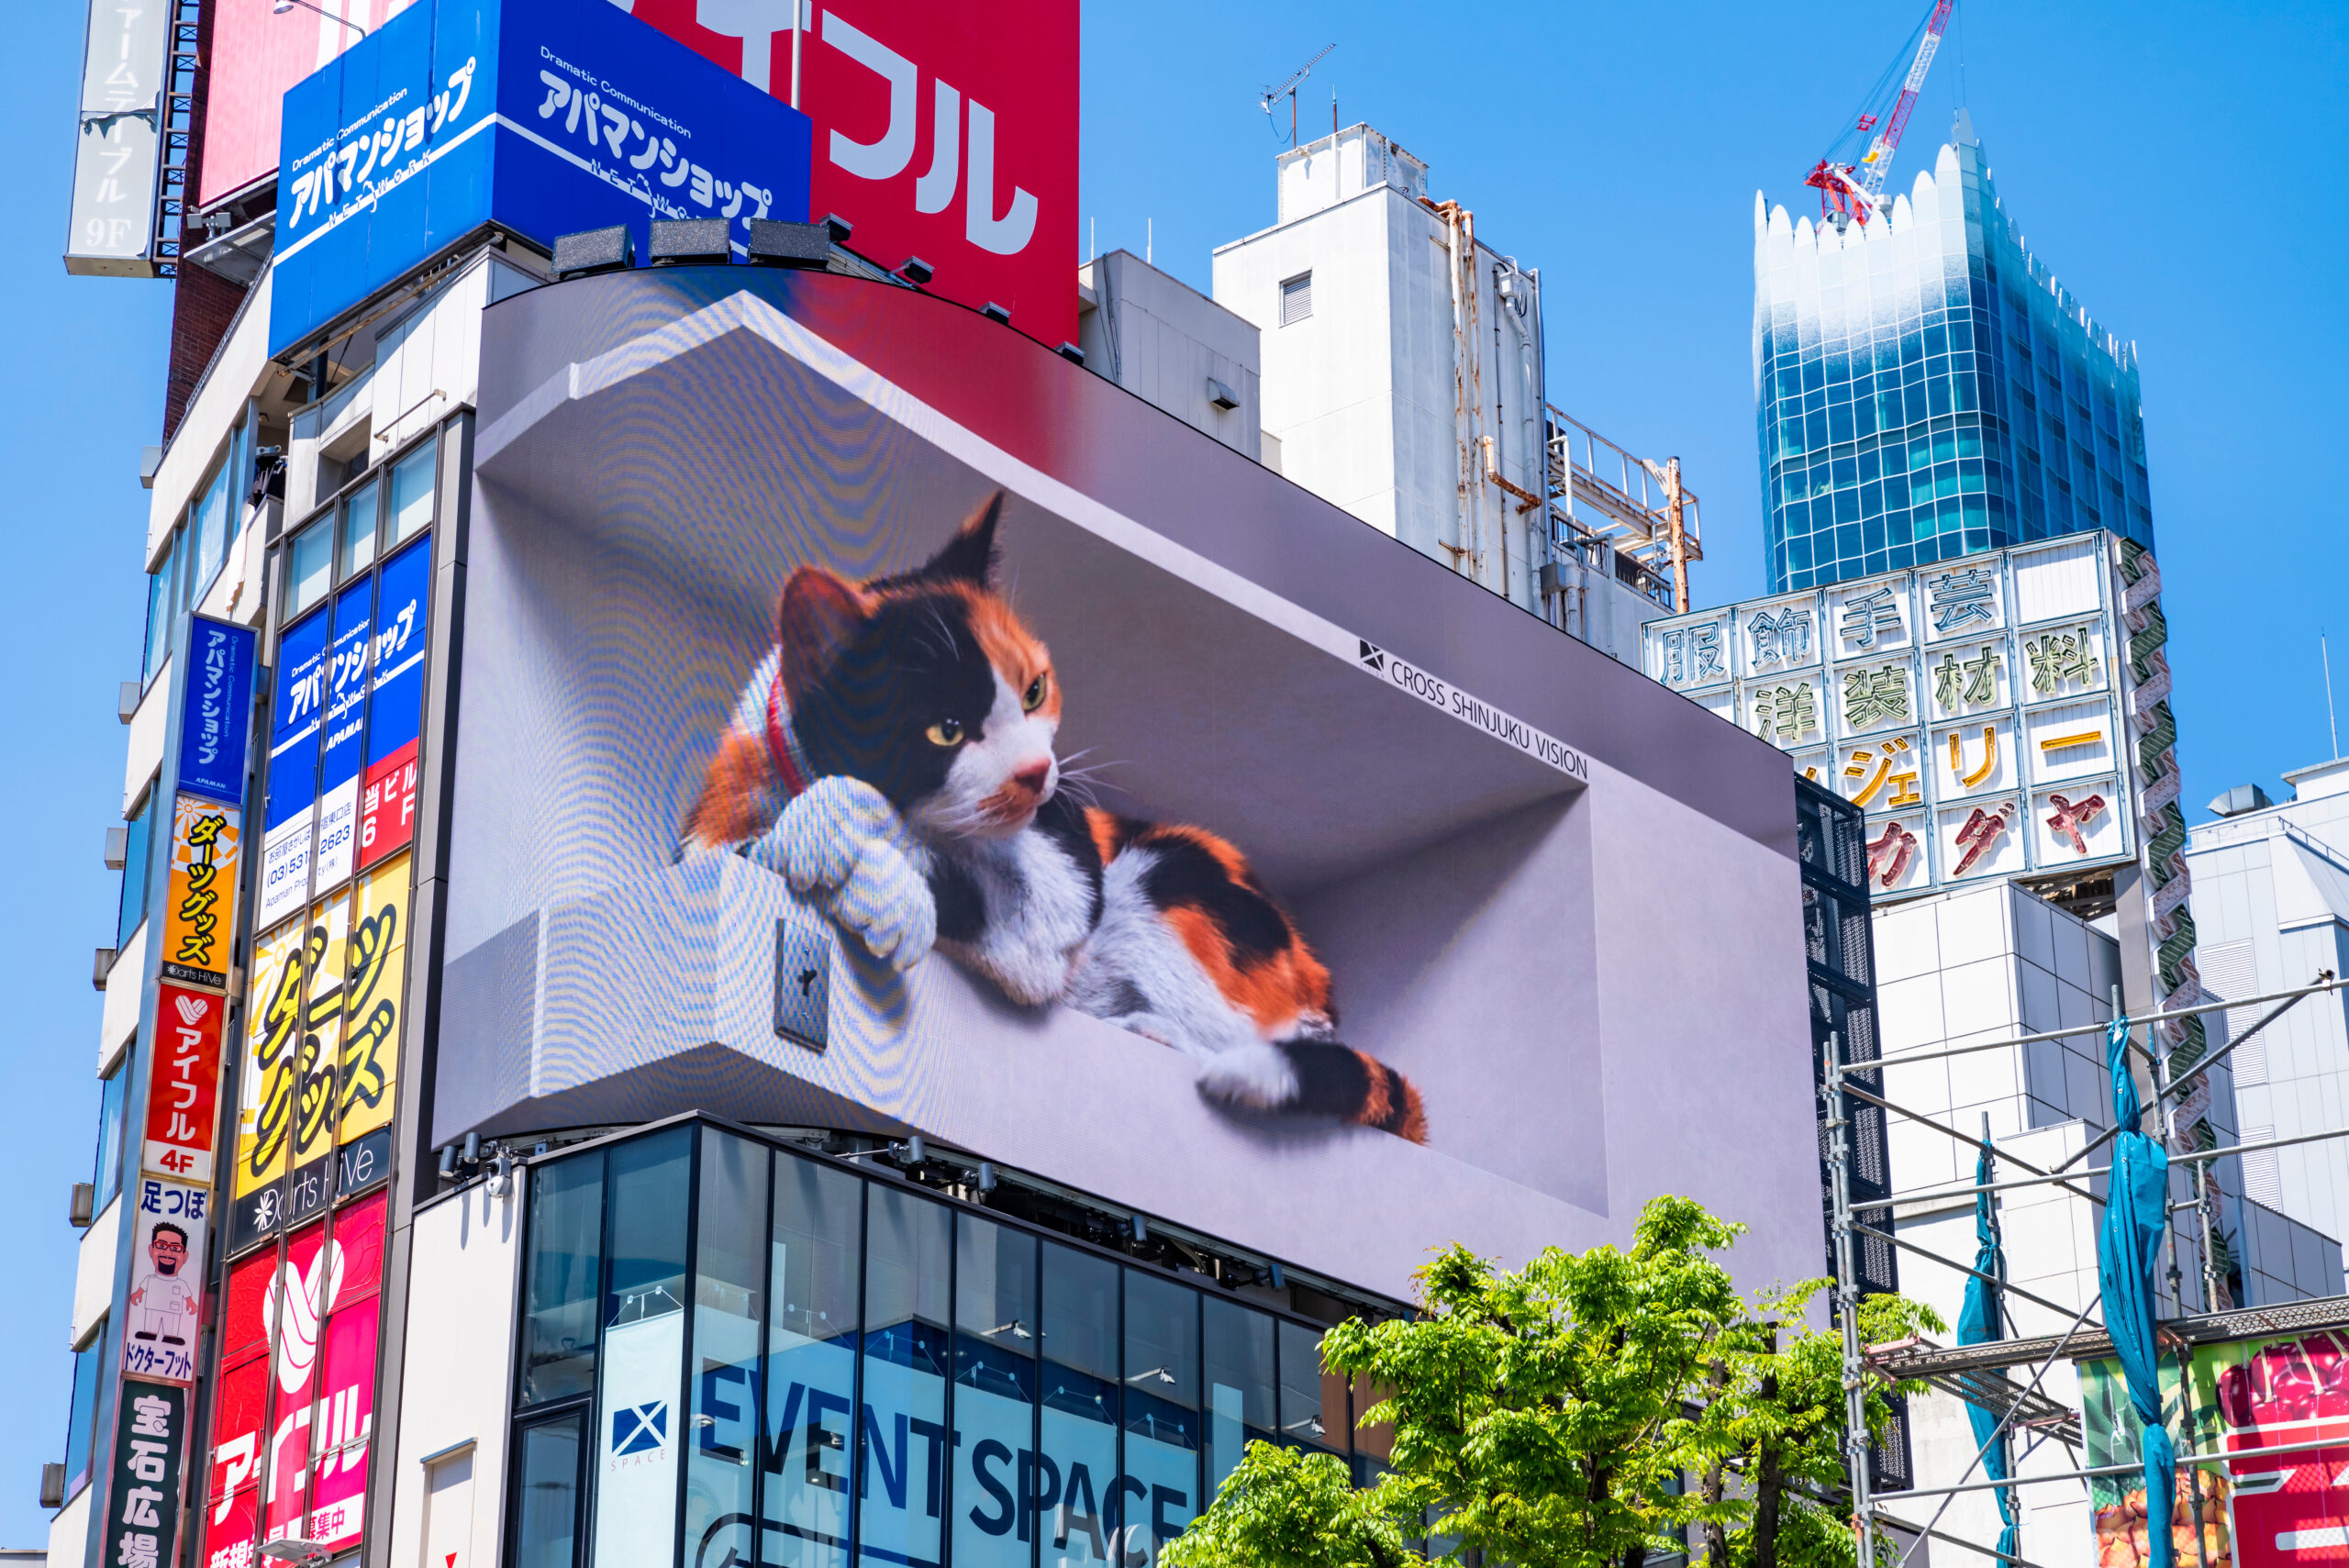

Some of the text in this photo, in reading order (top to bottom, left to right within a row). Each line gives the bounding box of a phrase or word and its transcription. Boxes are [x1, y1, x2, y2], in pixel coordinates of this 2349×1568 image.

[292, 88, 407, 172] Dramatic Communication
[540, 46, 692, 139] Dramatic Communication
[289, 56, 476, 228] アパマンショップ
[538, 69, 773, 230] アパマンショップ
[590, 158, 702, 219] NETWO
[85, 217, 132, 249] 9F
[292, 652, 321, 678] Dramatic
[1659, 568, 1995, 687] 服飾手芸
[198, 629, 227, 764] アパマンショップ
[224, 635, 239, 738] Dramatic Communication
[1391, 661, 1587, 780] CROSS SHINJUKU VISION
[1754, 627, 2099, 742] 洋装材料
[195, 777, 227, 789] APAMAN
[363, 762, 417, 817] 当ビル
[1806, 726, 2102, 808] ジェリー
[177, 815, 227, 964] ダーツグッズ
[166, 1027, 202, 1141] アイフル
[140, 1180, 206, 1220] 足つぼ
[160, 1149, 195, 1173] 4F
[125, 1342, 192, 1379] ドクターフット
[117, 1395, 172, 1568] 宝石広場
[610, 1449, 666, 1472] SPACE
[699, 1356, 1187, 1568] EVENT SPACE
